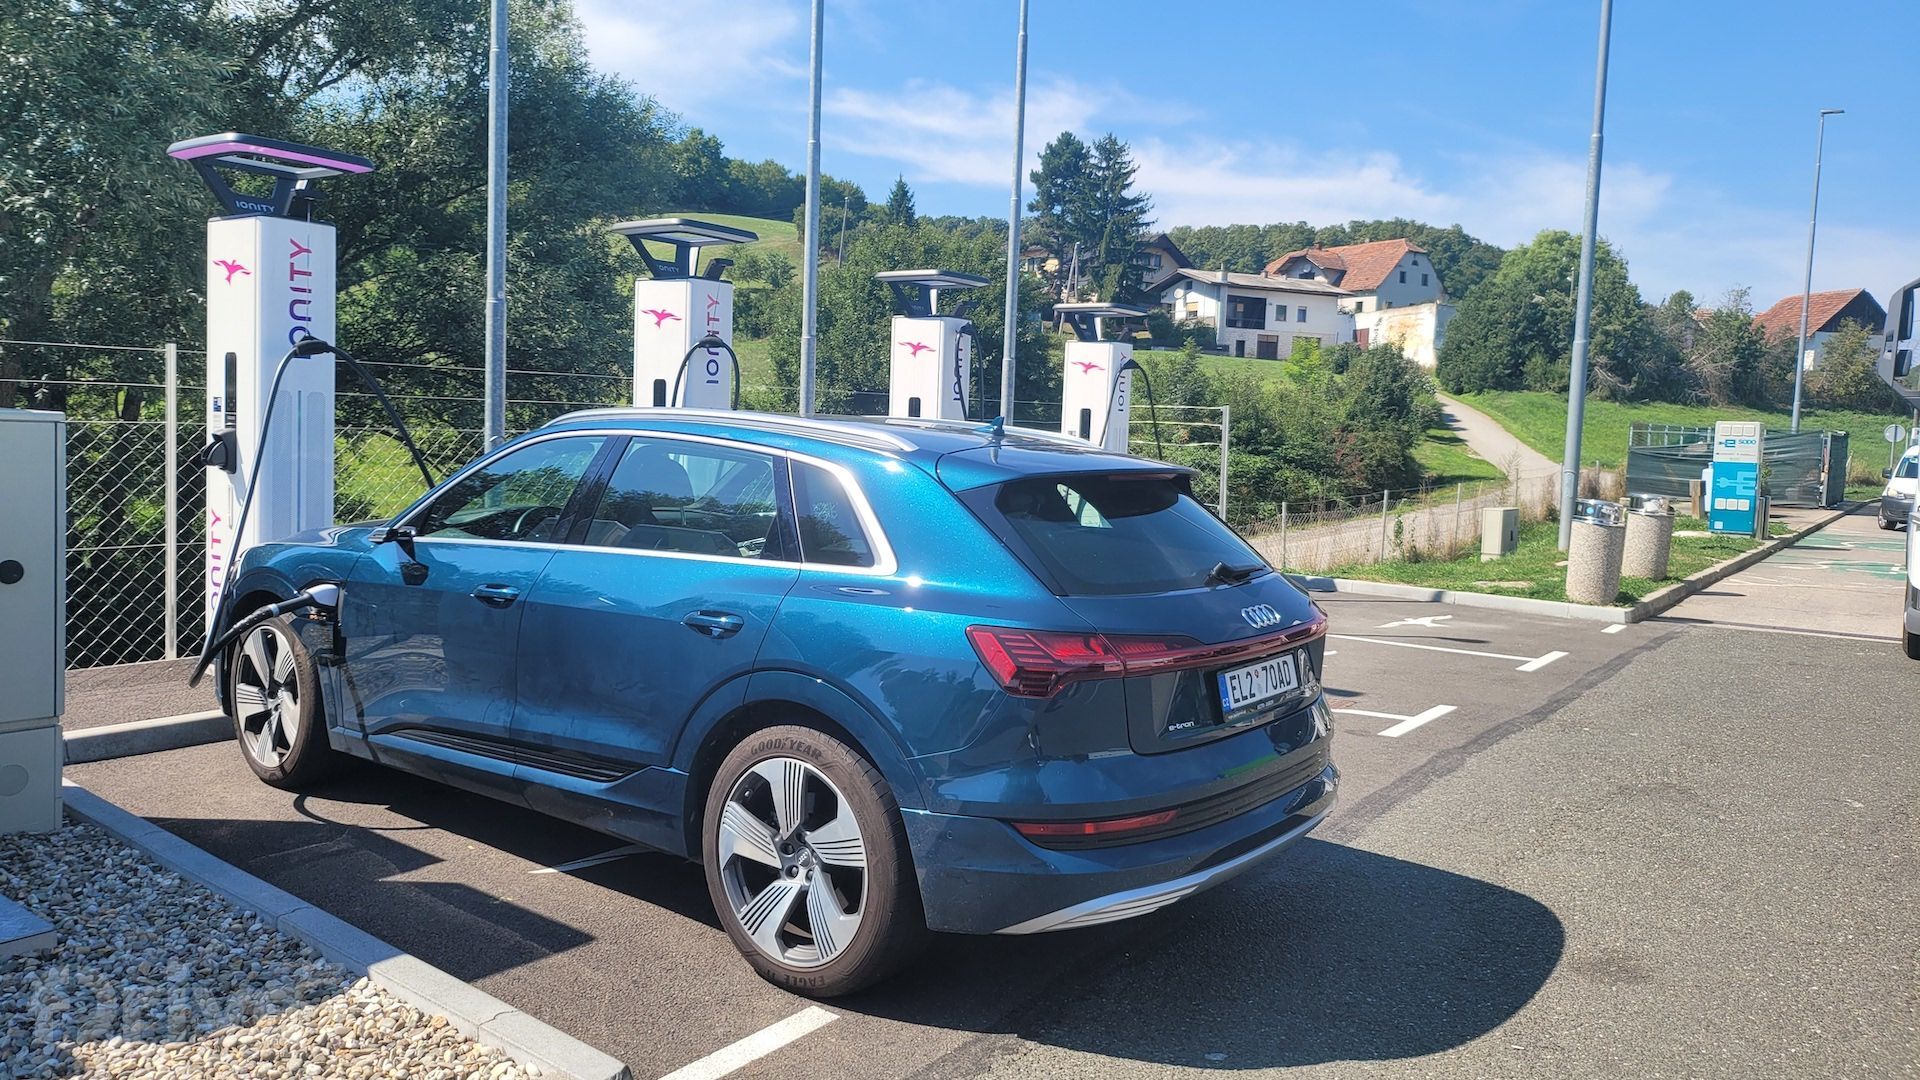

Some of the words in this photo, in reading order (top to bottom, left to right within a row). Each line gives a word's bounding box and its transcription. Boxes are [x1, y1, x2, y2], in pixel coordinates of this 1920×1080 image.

[235, 200, 275, 212] IONITY
[1117, 352, 1126, 412] IONIY
[210, 509, 222, 611] ONITY
[1168, 721, 1195, 731] e-tron
